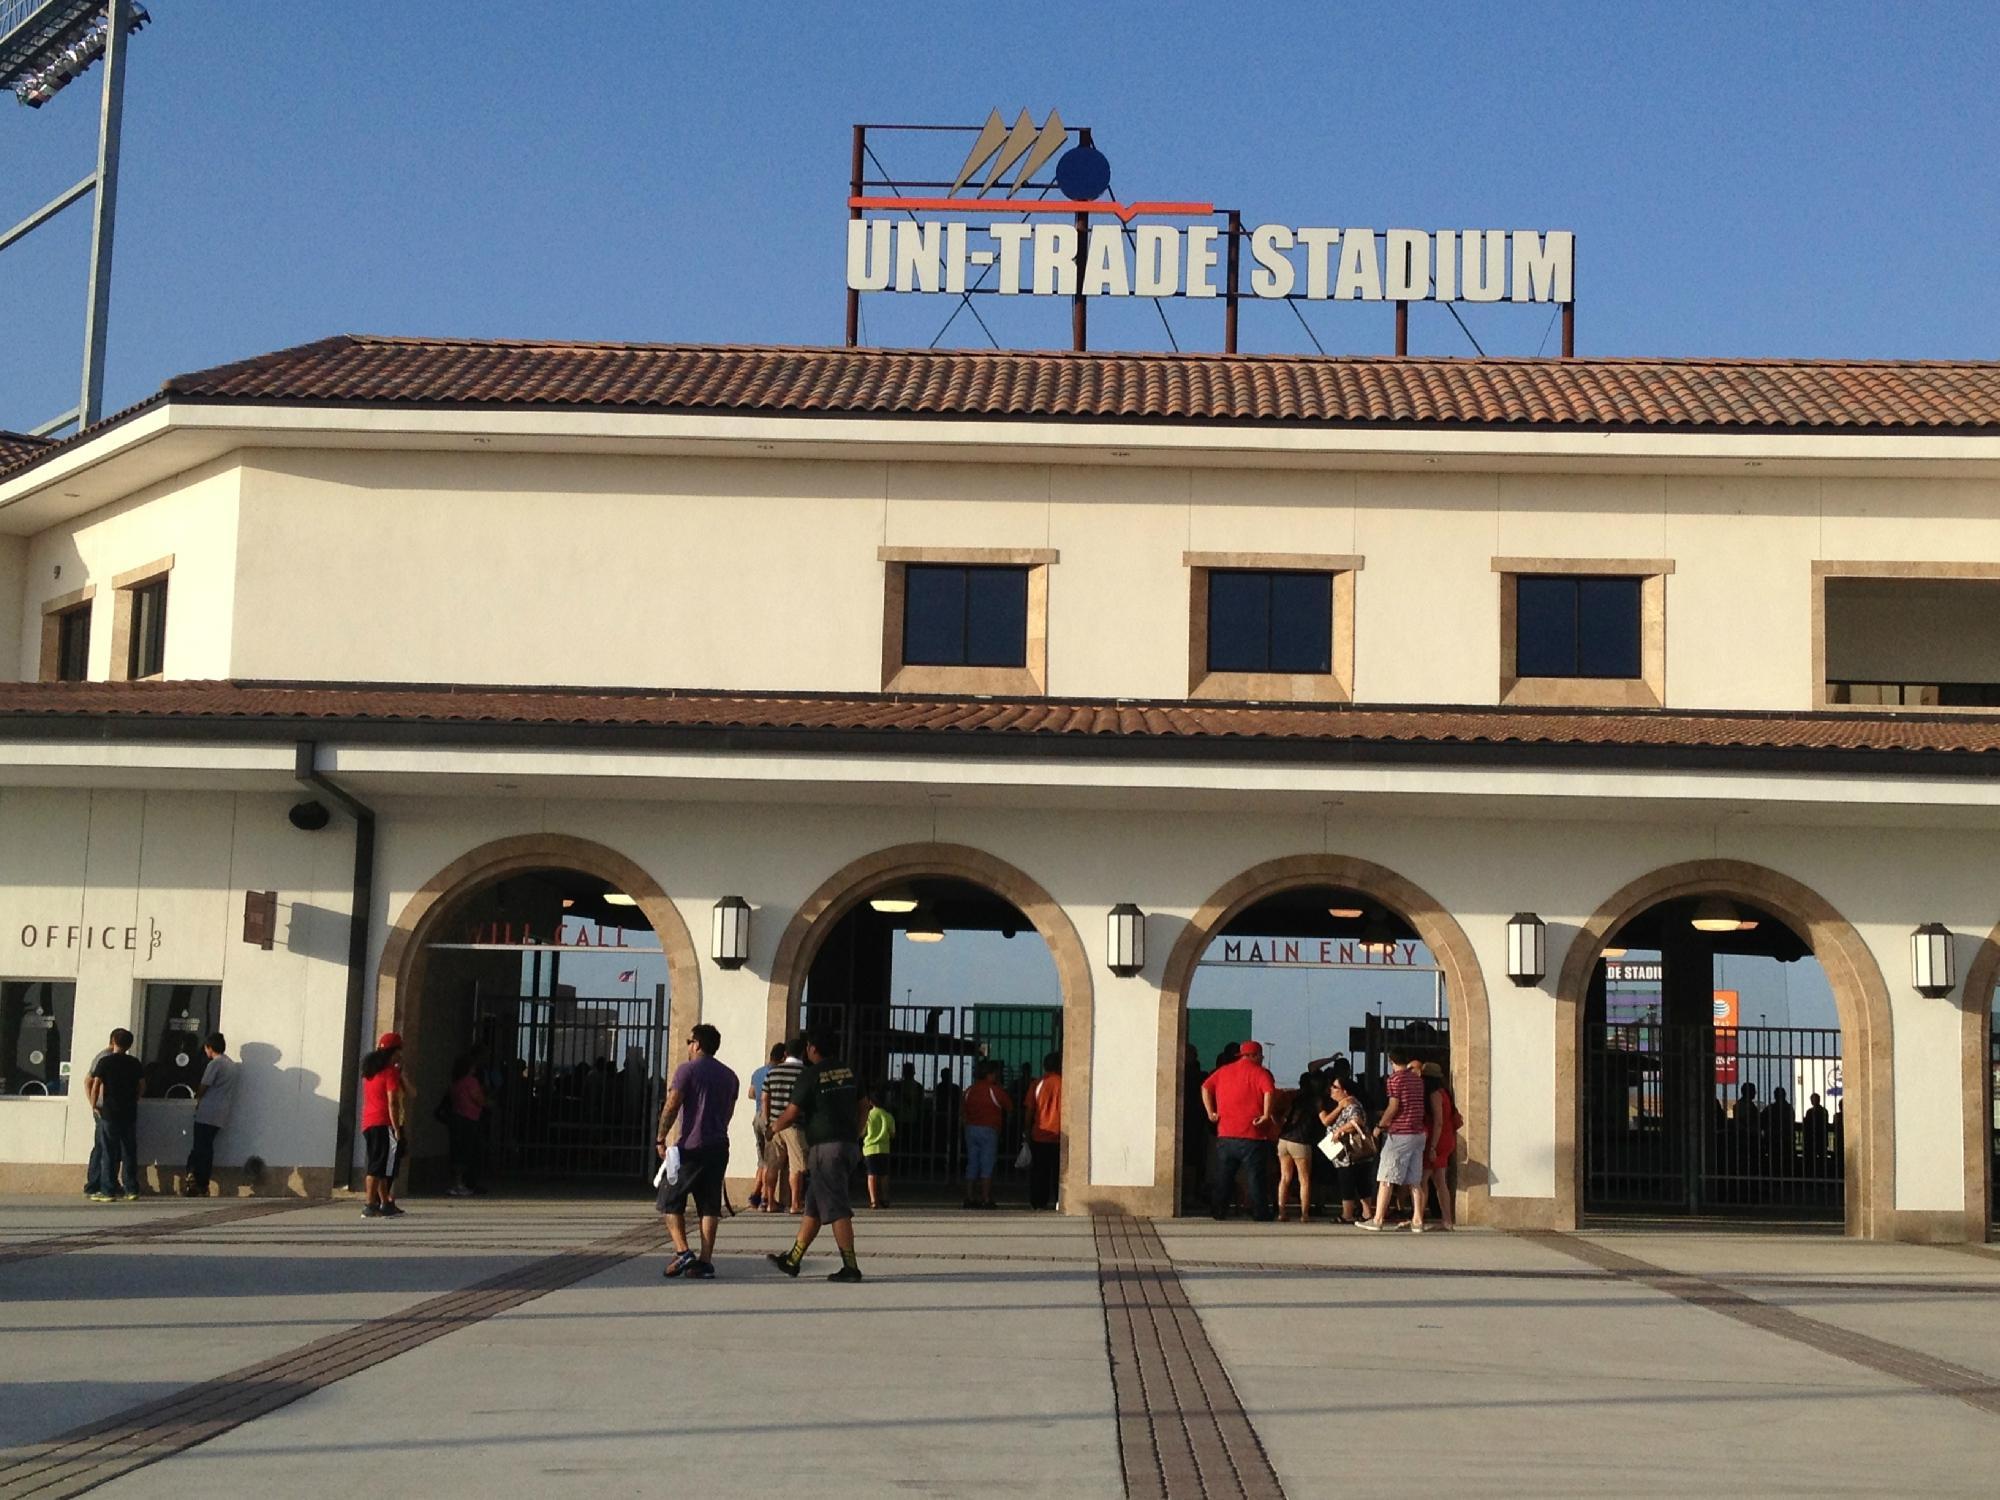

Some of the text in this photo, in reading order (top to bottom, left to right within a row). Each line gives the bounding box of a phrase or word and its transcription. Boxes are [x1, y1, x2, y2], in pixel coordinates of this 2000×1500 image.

[847, 219, 1573, 303] UNI-TRADE STADIUM
[21, 924, 137, 950] OFFICE
[555, 924, 628, 948] CALL
[1224, 939, 1416, 966] MAIN ENTRY
